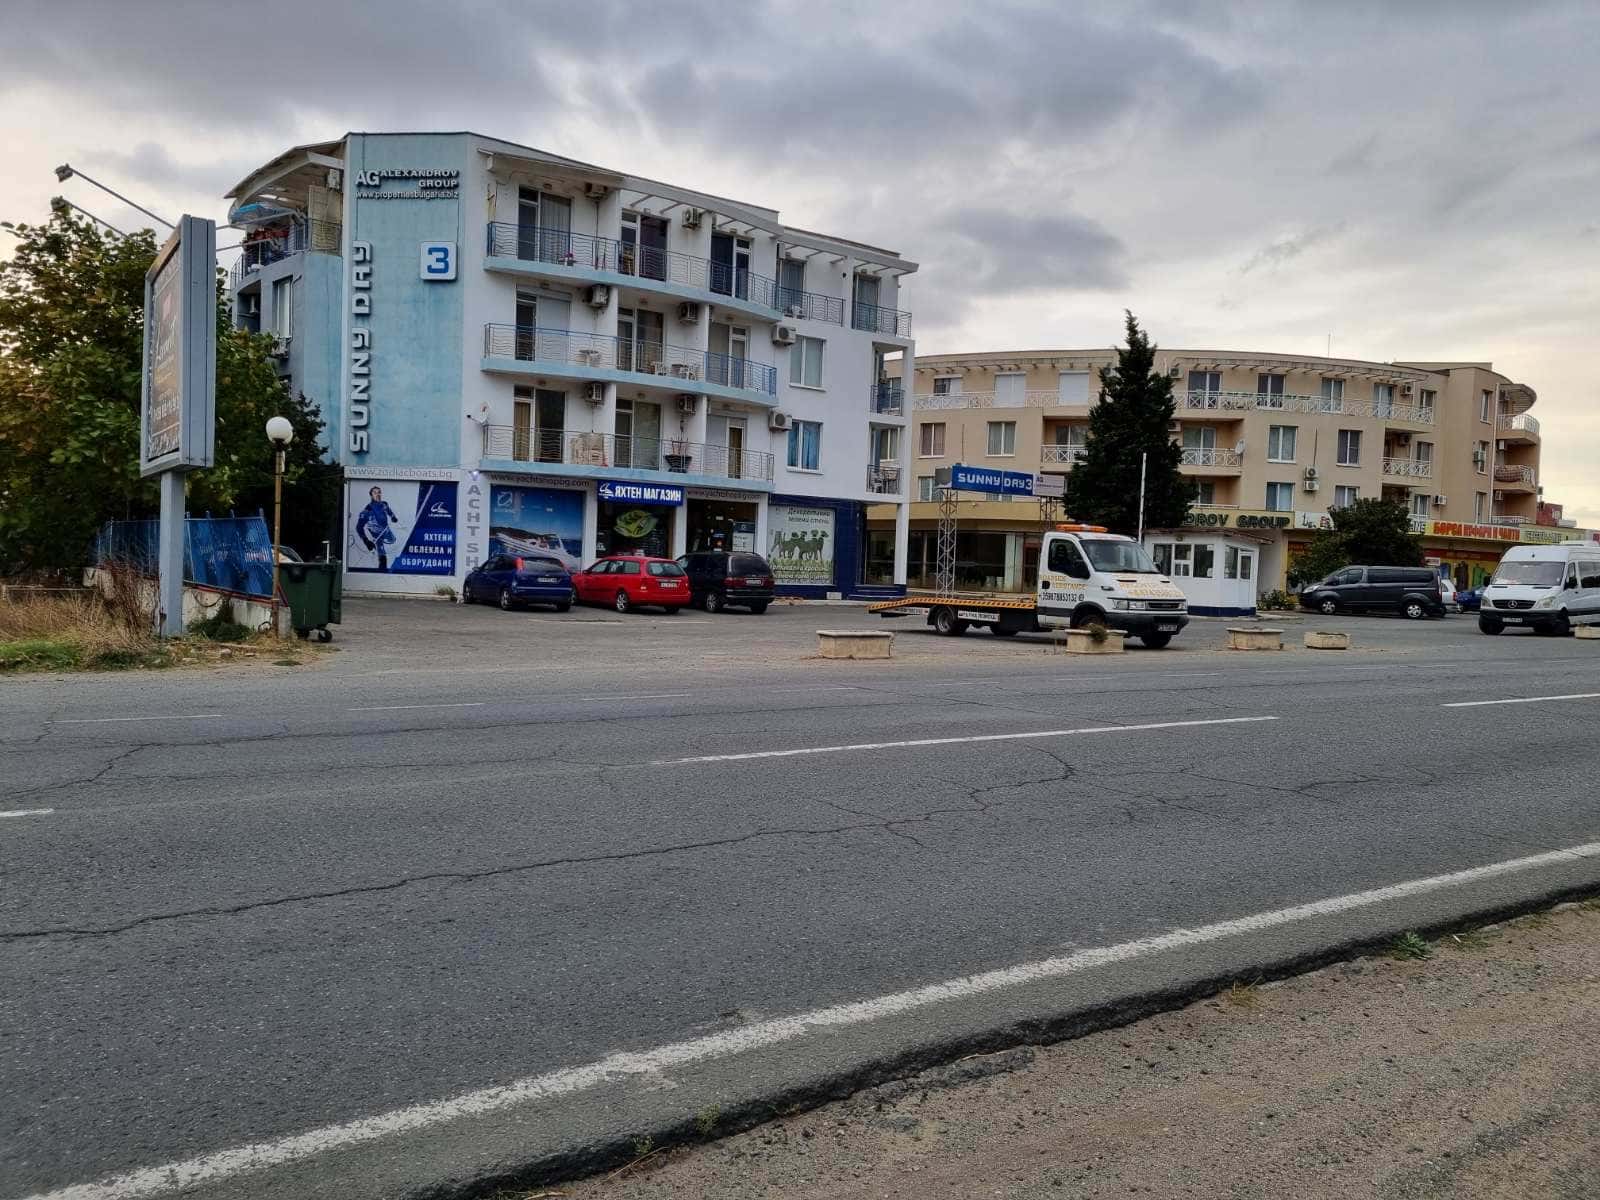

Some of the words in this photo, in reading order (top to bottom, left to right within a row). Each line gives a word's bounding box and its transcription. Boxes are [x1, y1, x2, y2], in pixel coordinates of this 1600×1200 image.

[355, 170, 380, 186] AG
[380, 169, 459, 178] ALEXANDROV
[418, 179, 458, 188] GROUP
[427, 247, 450, 274] 3
[350, 327, 369, 452] SUNNY
[958, 473, 1001, 486] SUNNY
[614, 485, 643, 499] ЯХТЕН
[643, 488, 682, 502] МАГАЗИН
[1236, 515, 1291, 528] GROUP
[424, 533, 453, 542] ЯХТЕНИ
[408, 545, 445, 554] ОБЛЕКЛА
[447, 546, 453, 555] И
[401, 558, 452, 568] ОБОРУДВАНЕ
